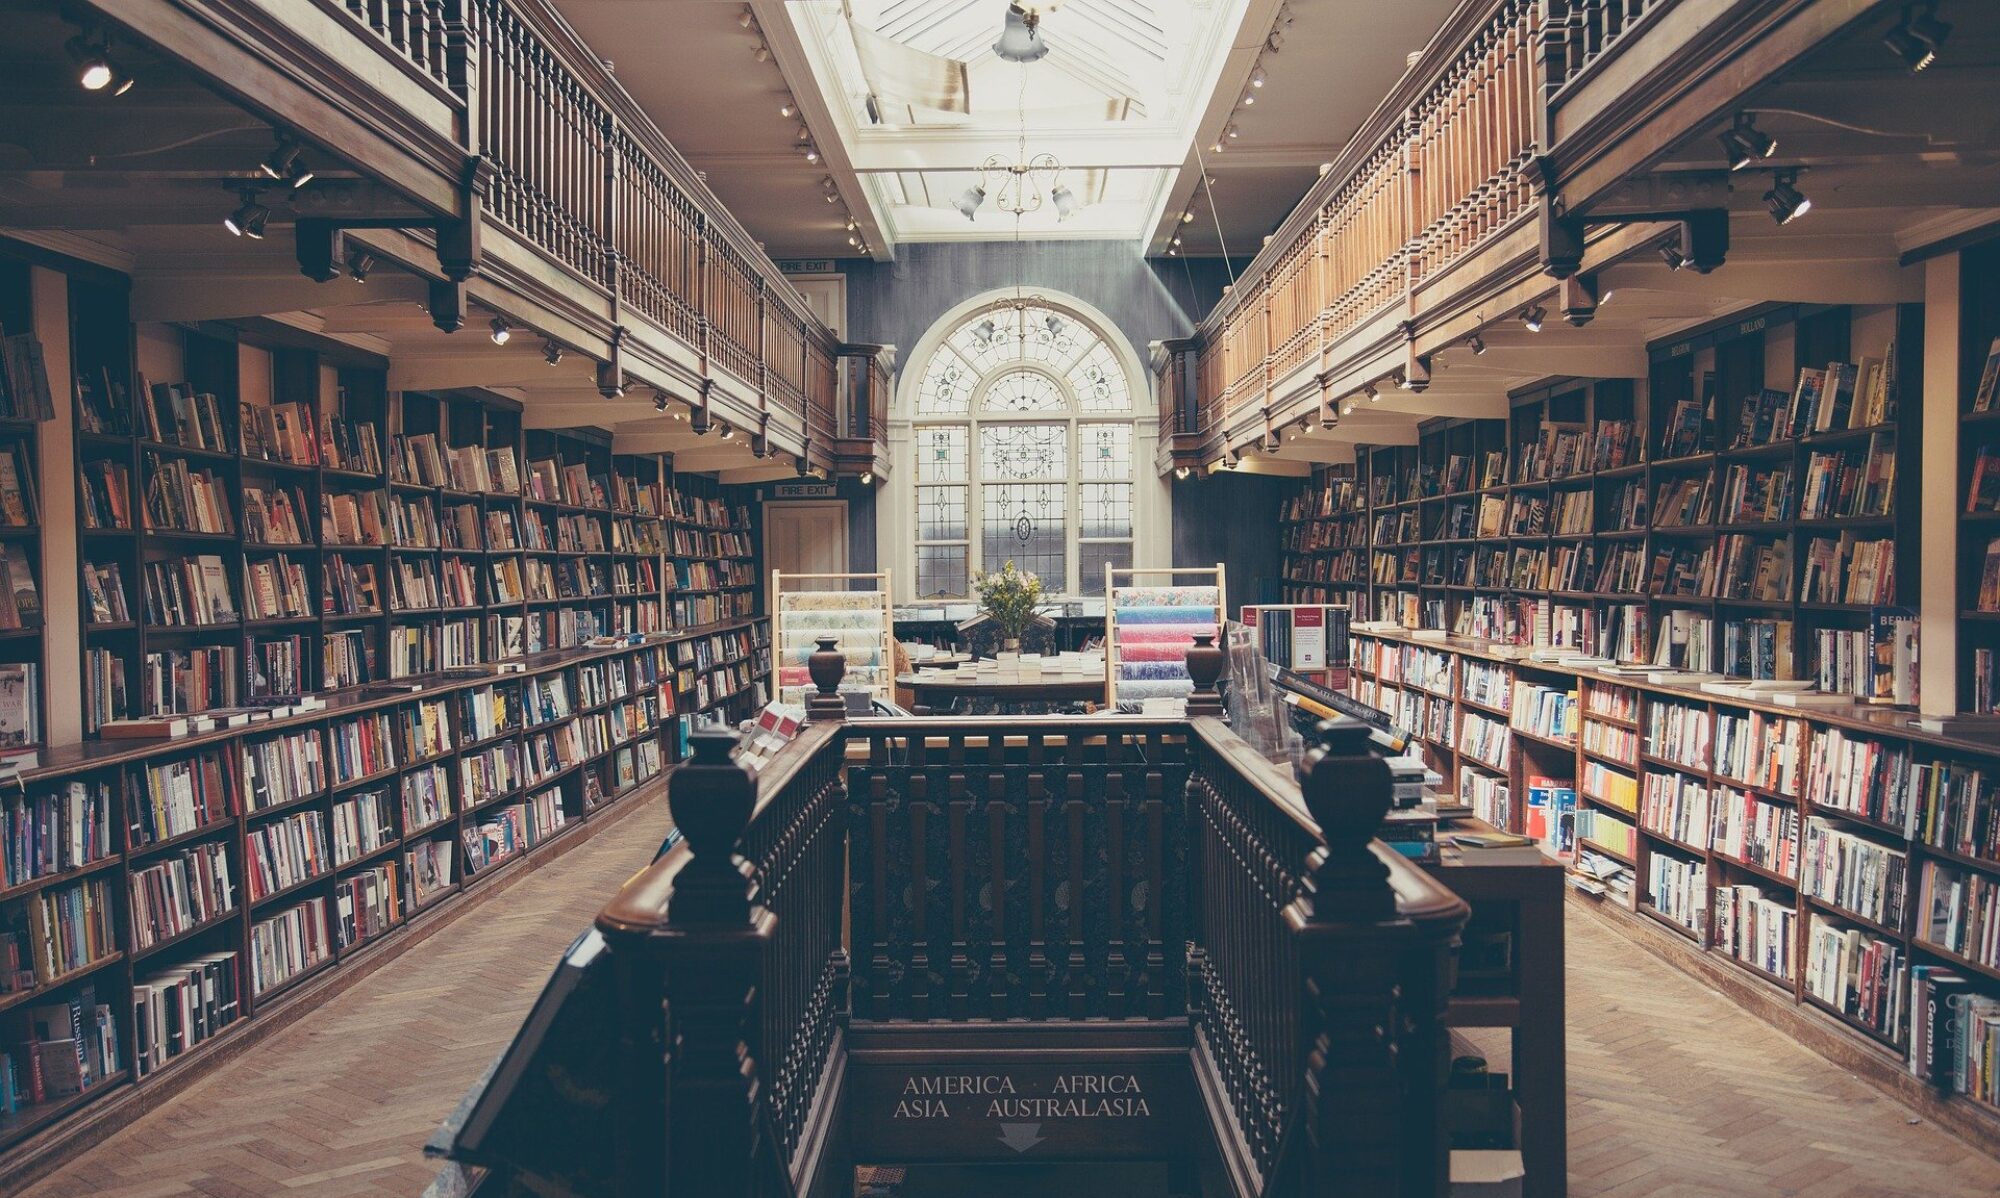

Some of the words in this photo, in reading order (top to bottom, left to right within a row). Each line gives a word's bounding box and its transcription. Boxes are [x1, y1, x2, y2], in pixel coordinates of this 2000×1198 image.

[780, 261, 802, 271] FIRE
[806, 261, 828, 271] EXIT
[782, 486, 803, 495] FIRE
[807, 486, 829, 495] EXIT
[497, 823, 505, 860] VISUAL
[72, 1005, 85, 1061] Russian
[1926, 999, 1937, 1066] German
[903, 1075, 1015, 1096] AMERICA
[1052, 1075, 1141, 1095] AFRICA
[894, 1099, 949, 1118] ASIA
[986, 1098, 1150, 1118] AUSTRALASIA
